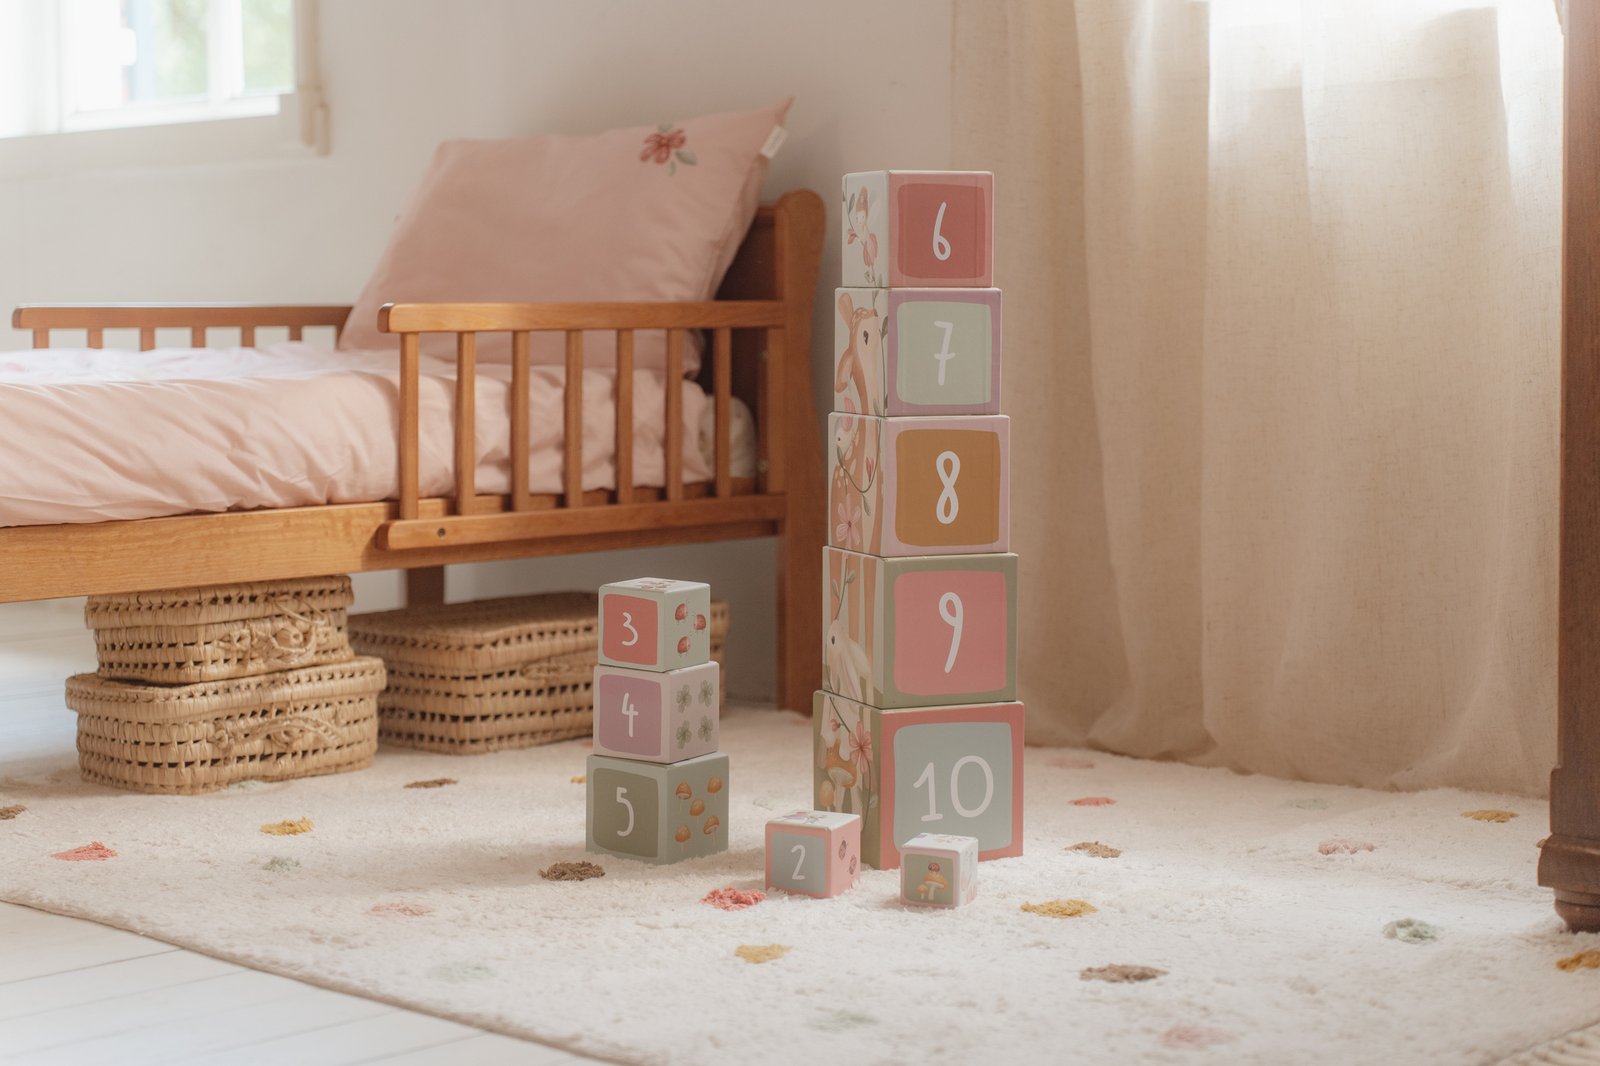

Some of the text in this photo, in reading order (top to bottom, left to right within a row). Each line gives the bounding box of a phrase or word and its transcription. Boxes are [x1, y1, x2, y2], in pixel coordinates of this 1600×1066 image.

[933, 202, 951, 260] 6
[934, 320, 956, 385] 7
[936, 451, 960, 524] 8
[621, 612, 638, 646] 3
[939, 592, 963, 673] 9
[622, 692, 638, 737] 4
[616, 787, 634, 836] 5
[913, 756, 993, 821] 10
[791, 845, 805, 880] 2
